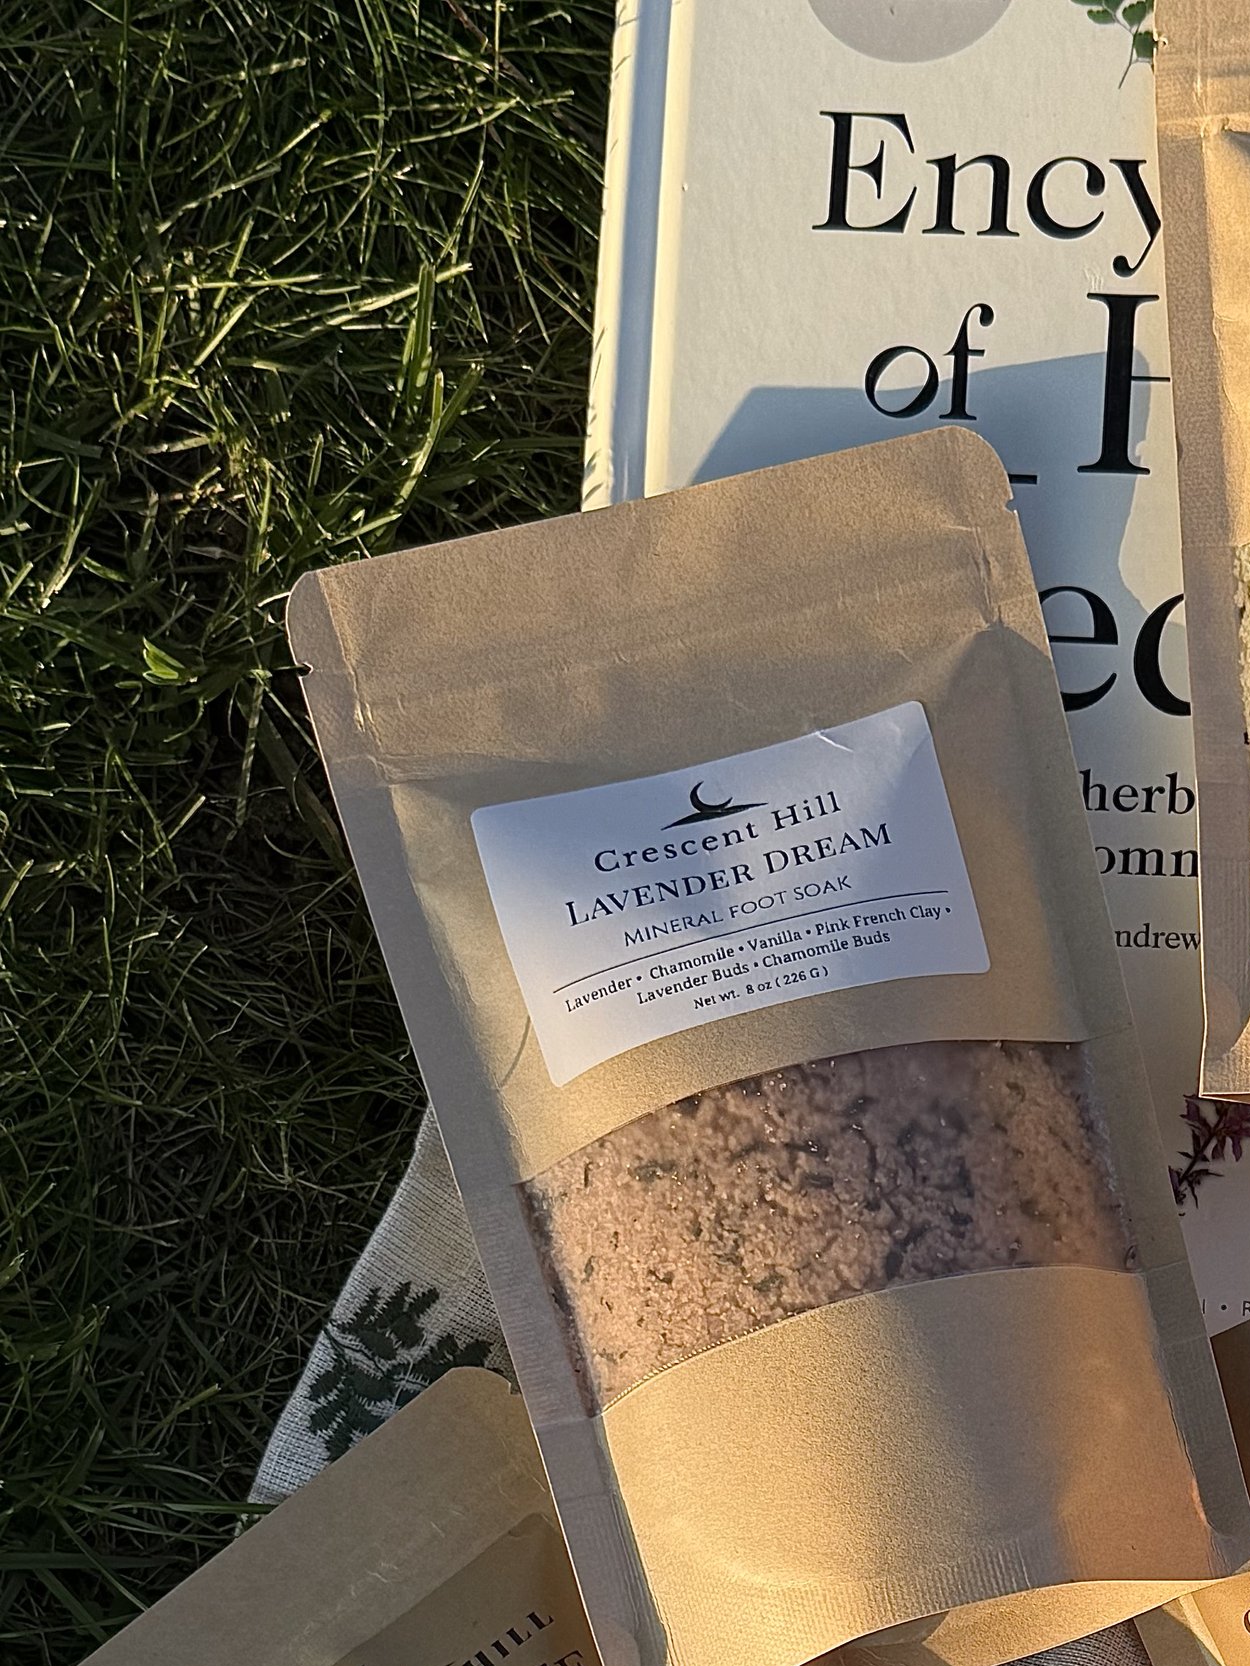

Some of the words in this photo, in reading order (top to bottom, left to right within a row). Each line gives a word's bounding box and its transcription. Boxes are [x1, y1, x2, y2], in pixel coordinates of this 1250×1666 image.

[811, 110, 1161, 278] Ency
[865, 303, 994, 419] of
[566, 864, 755, 926] LAVENDER
[763, 823, 891, 875] DREAM
[594, 823, 758, 872] Crescent
[773, 791, 841, 831] Hill
[625, 909, 723, 946] MINERAL
[729, 892, 790, 919] FOOT
[794, 876, 851, 900] SOAK
[565, 979, 633, 1012] Lavender
[650, 945, 735, 980] Chamomile
[748, 929, 803, 953] Vanilla
[815, 918, 850, 937] Pink
[853, 908, 906, 927] French
[910, 904, 941, 922] Clay
[637, 974, 708, 1004] Lavender
[712, 961, 750, 983] Buds
[763, 937, 849, 968] Chamomile
[853, 931, 890, 949] Buds
[693, 995, 717, 1010] Net
[747, 983, 754, 994] 8
[757, 981, 772, 991] oz
